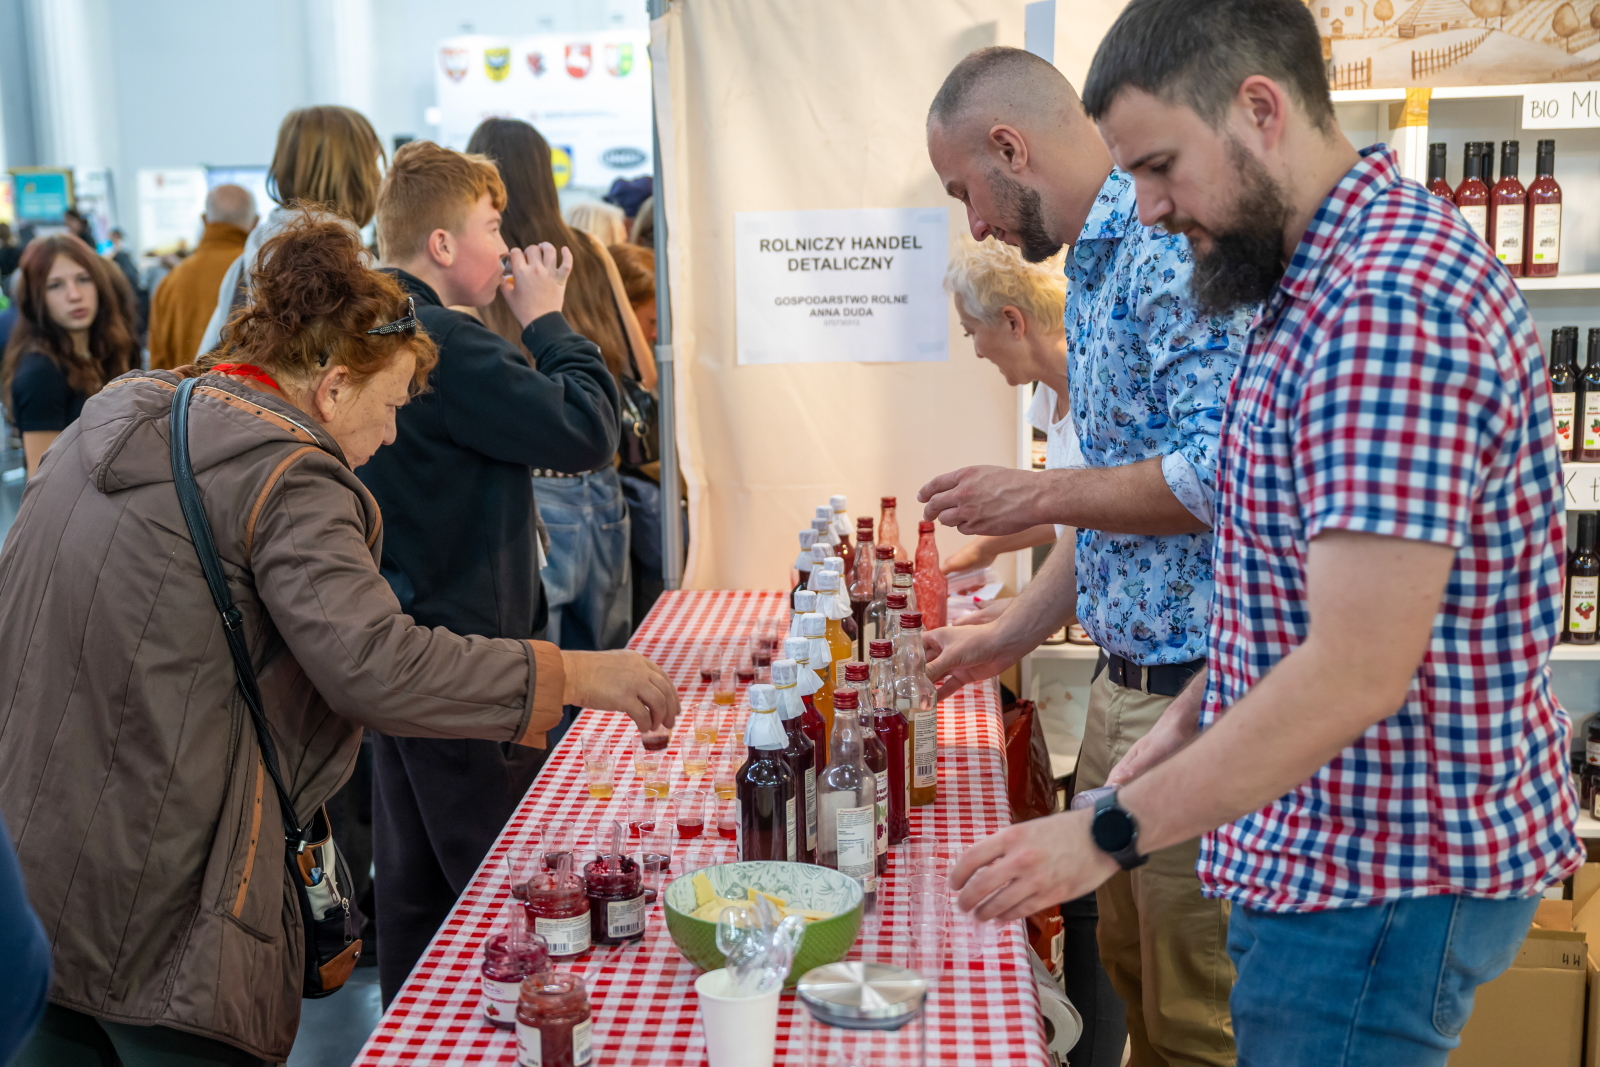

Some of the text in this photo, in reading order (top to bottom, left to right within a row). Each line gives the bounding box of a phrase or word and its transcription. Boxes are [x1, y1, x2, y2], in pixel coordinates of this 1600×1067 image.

[1531, 100, 1559, 118] BIO
[760, 236, 923, 252] ROLNICZY HANDEL
[788, 256, 894, 271] DETALICZNY
[774, 294, 909, 306] GOSPODARSTWO ROLNE
[809, 307, 874, 318] ANNA DUDA
